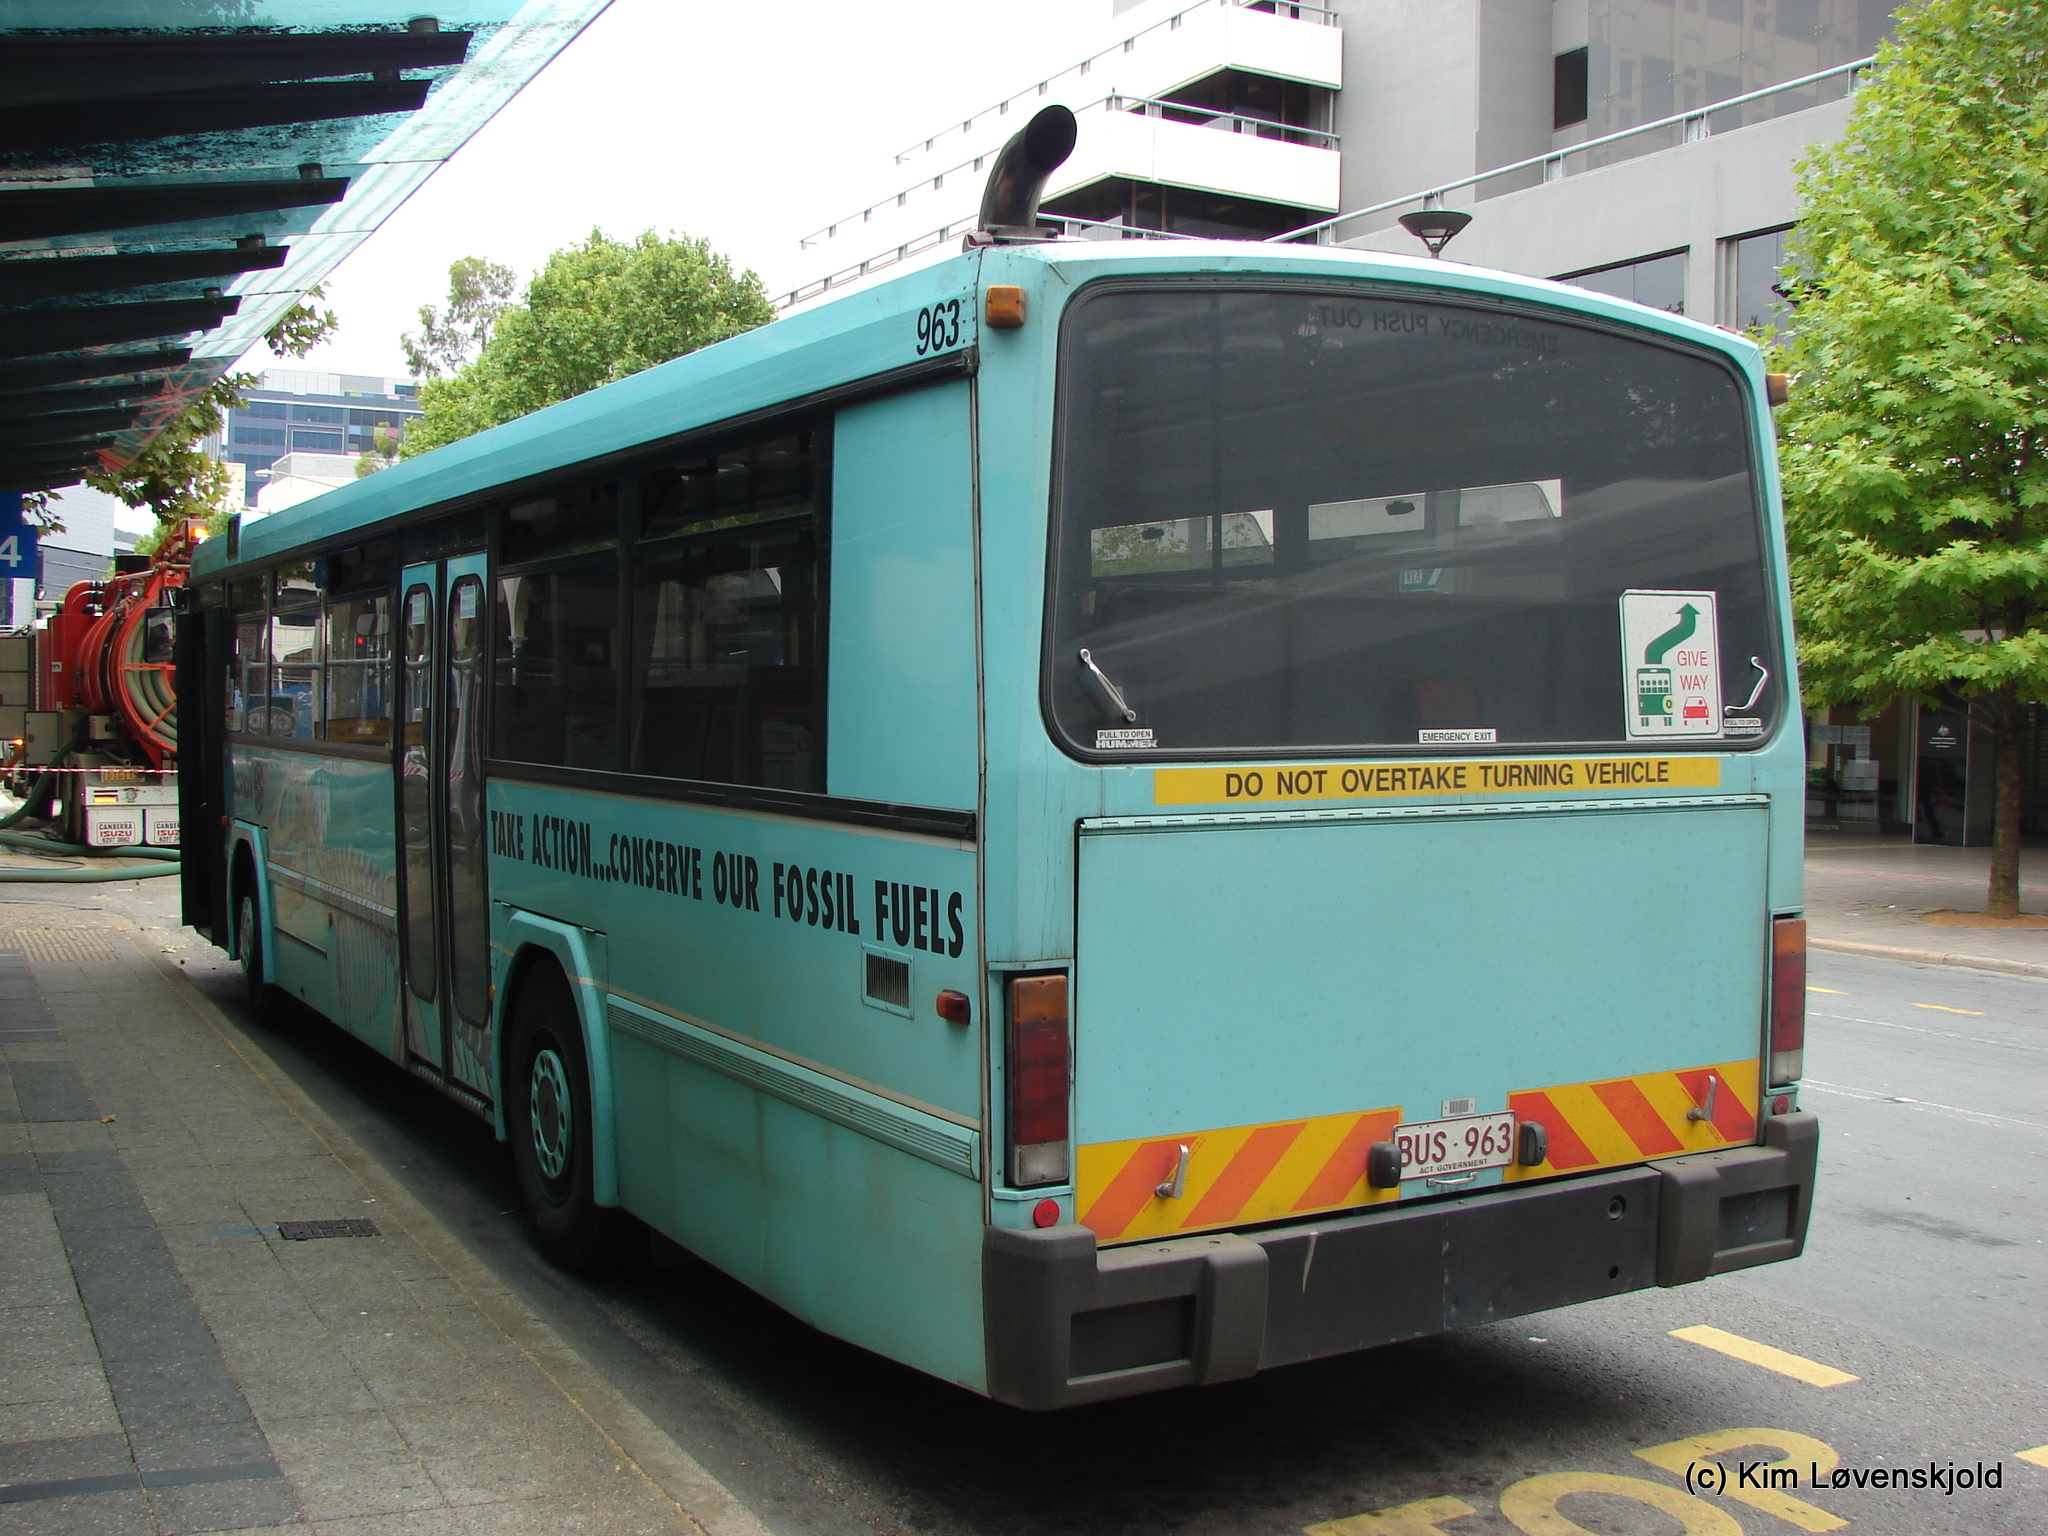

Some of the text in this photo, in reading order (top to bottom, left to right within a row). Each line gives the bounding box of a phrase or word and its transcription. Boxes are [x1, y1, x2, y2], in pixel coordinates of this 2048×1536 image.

[916, 299, 960, 356] 963
[0, 535, 22, 568] 4
[1677, 650, 1708, 666] GIVE
[1680, 675, 1709, 690] WAY
[1099, 731, 1118, 739] PULL
[1131, 730, 1151, 738] OPEN
[1422, 732, 1492, 741] EMERGENCY EXIT
[1095, 739, 1159, 749] HUMMER
[1225, 761, 1670, 798] DO NOT OVERTAKE TURNING VEHICLE
[99, 822, 132, 830] CANBERRA
[156, 822, 180, 830] CANBER
[490, 809, 525, 861] TAKE
[712, 850, 760, 913] OUR
[773, 861, 861, 936] FOSSIL
[874, 879, 965, 959] FUELS
[1397, 1122, 1511, 1168] BUS 963
[1419, 1158, 1488, 1175] ACT GOVERNMENT
